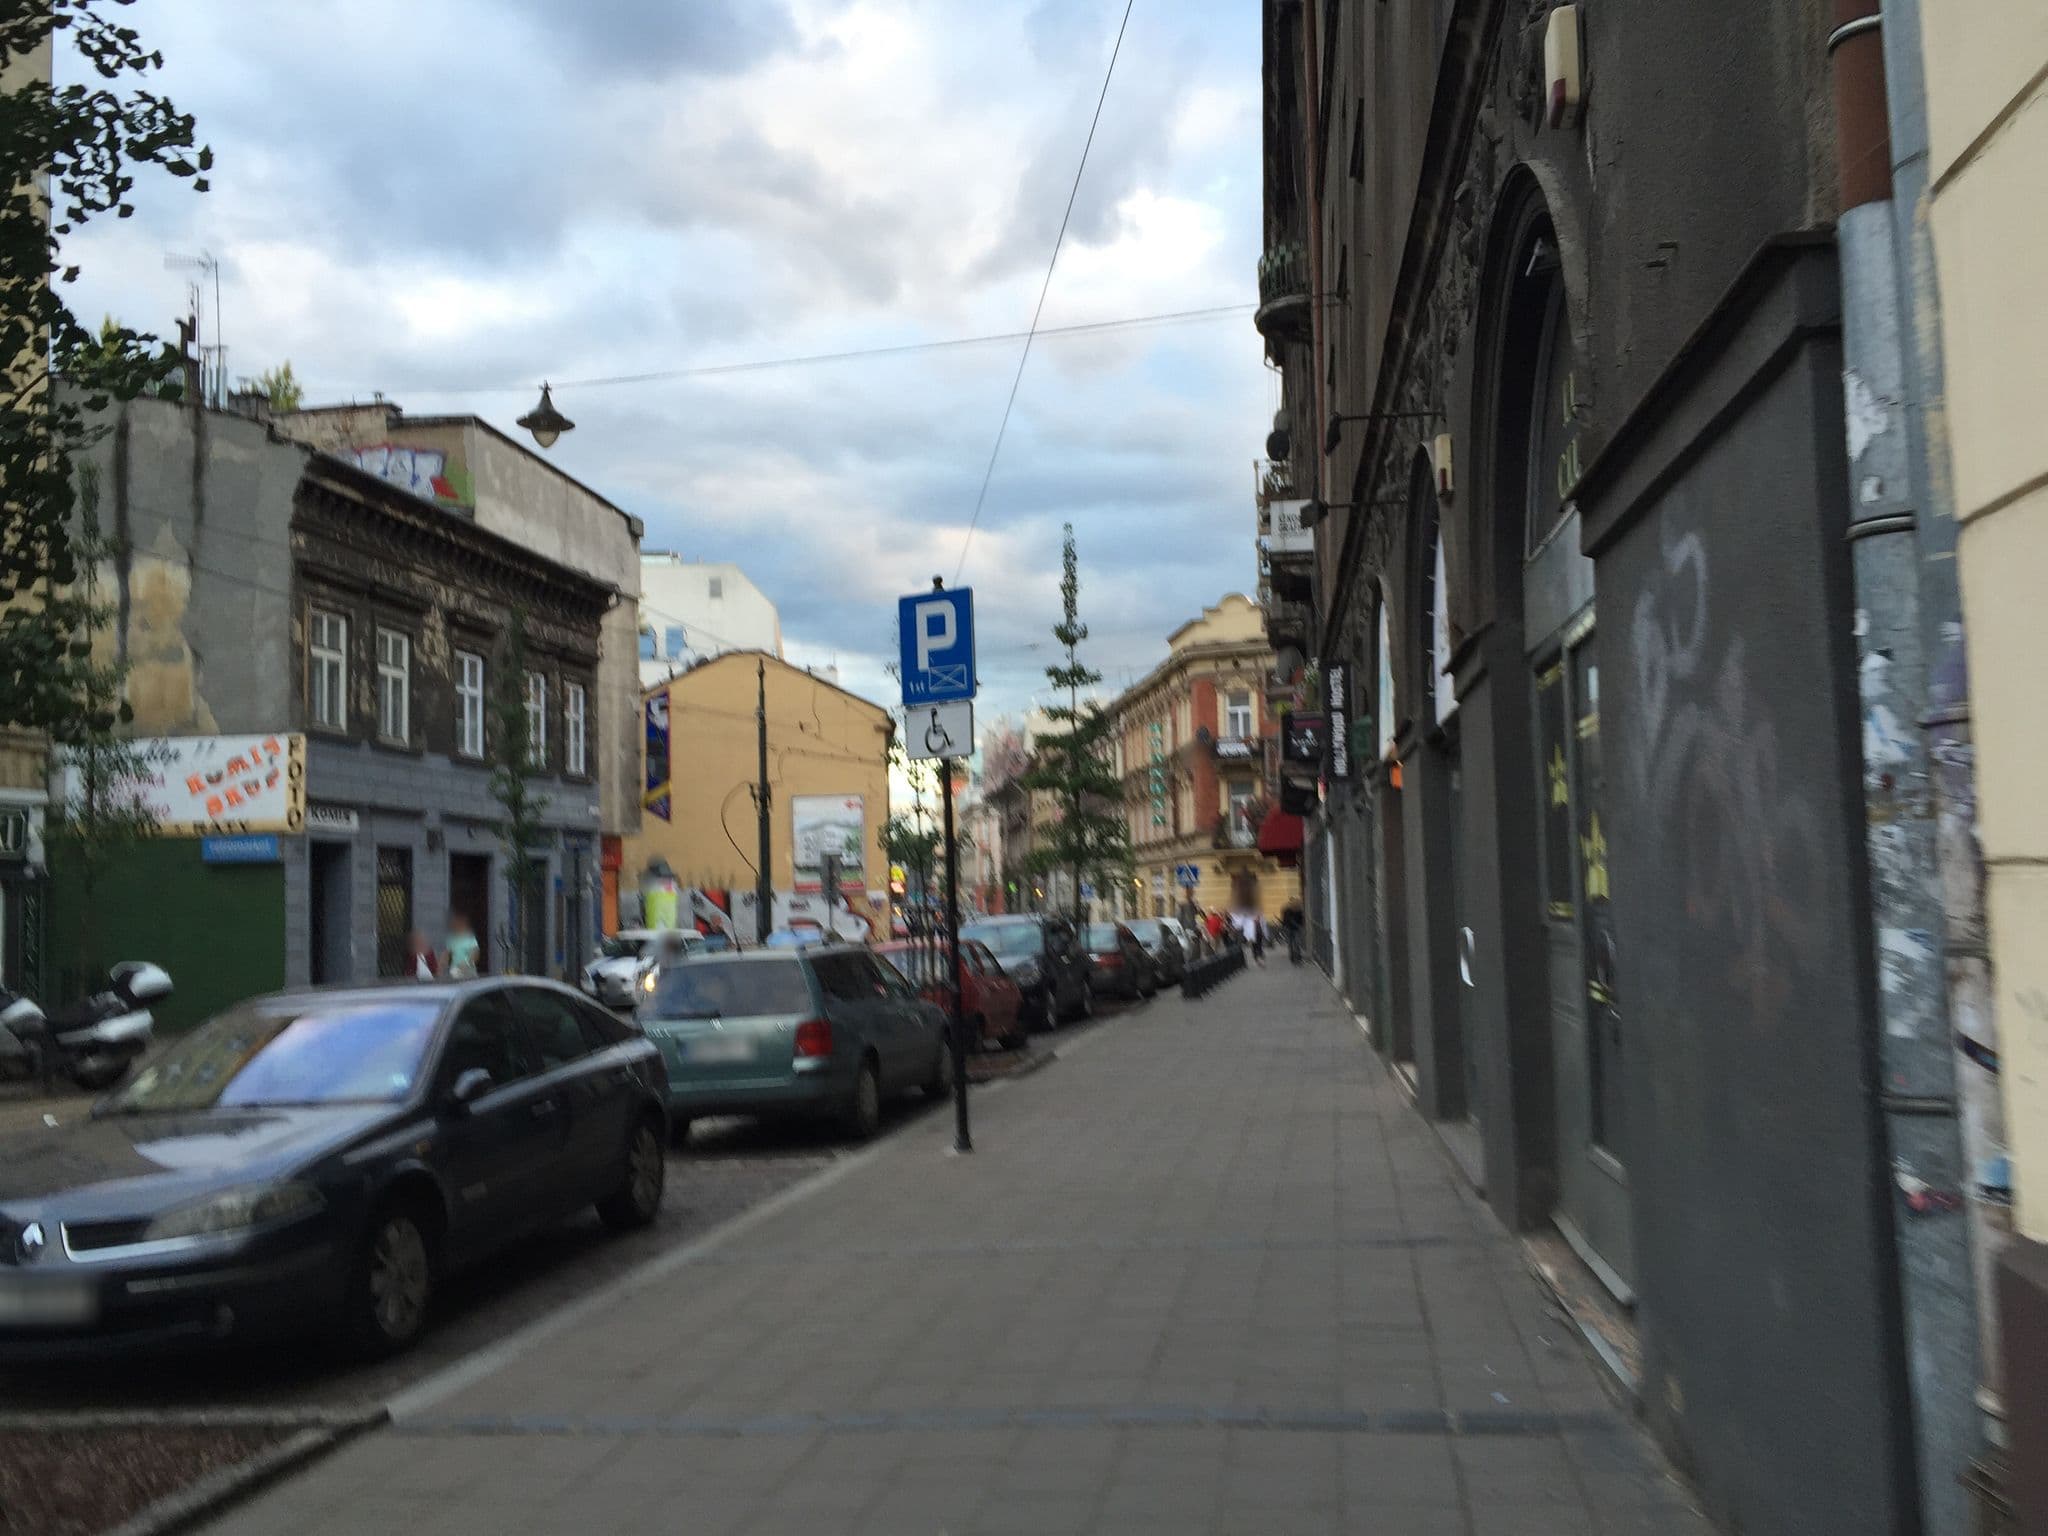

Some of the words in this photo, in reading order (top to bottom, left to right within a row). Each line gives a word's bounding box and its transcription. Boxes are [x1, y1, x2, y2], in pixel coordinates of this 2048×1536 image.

[915, 600, 957, 672] P
[1329, 664, 1344, 709] HOSTEL
[287, 736, 303, 831] FOTO
